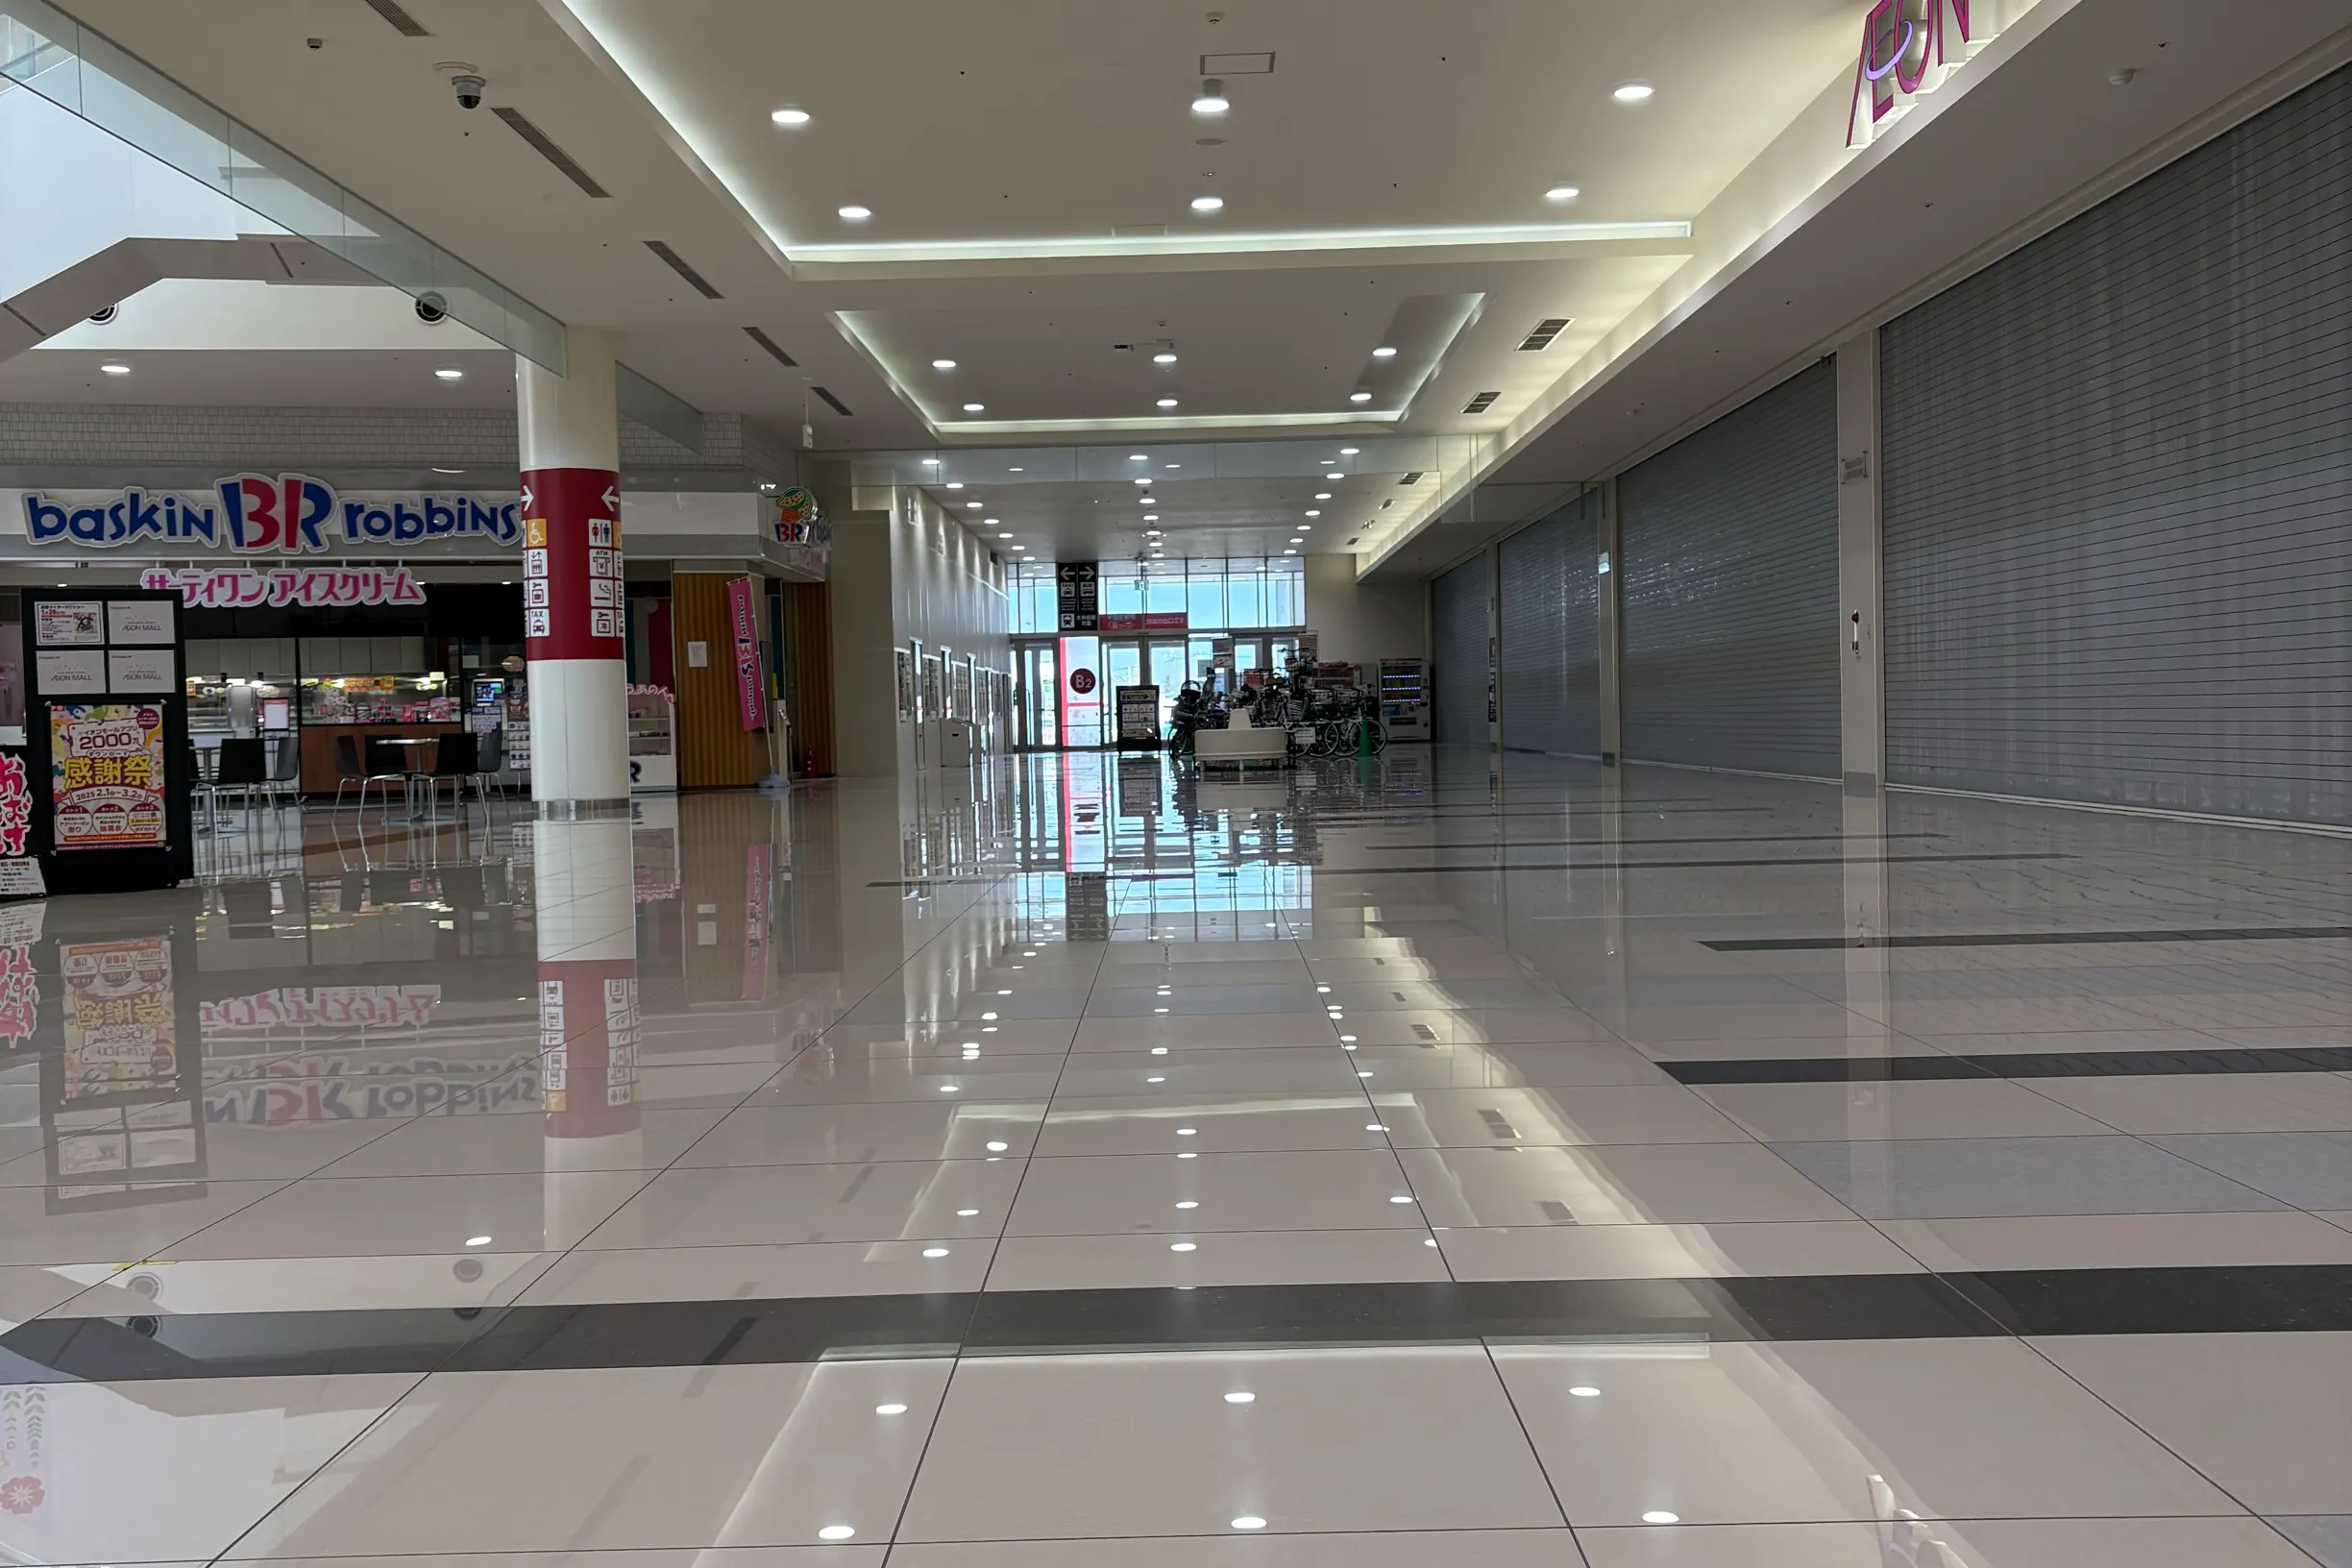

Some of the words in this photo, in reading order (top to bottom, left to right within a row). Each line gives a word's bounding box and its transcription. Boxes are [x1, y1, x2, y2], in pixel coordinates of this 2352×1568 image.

[221, 478, 333, 549] BR
[271, 574, 421, 602] アイスクリーム
[1075, 674, 1092, 689] B2
[84, 725, 138, 736] イオンモールアプリ
[64, 755, 153, 789] 感謝祭
[76, 792, 96, 801] 2025
